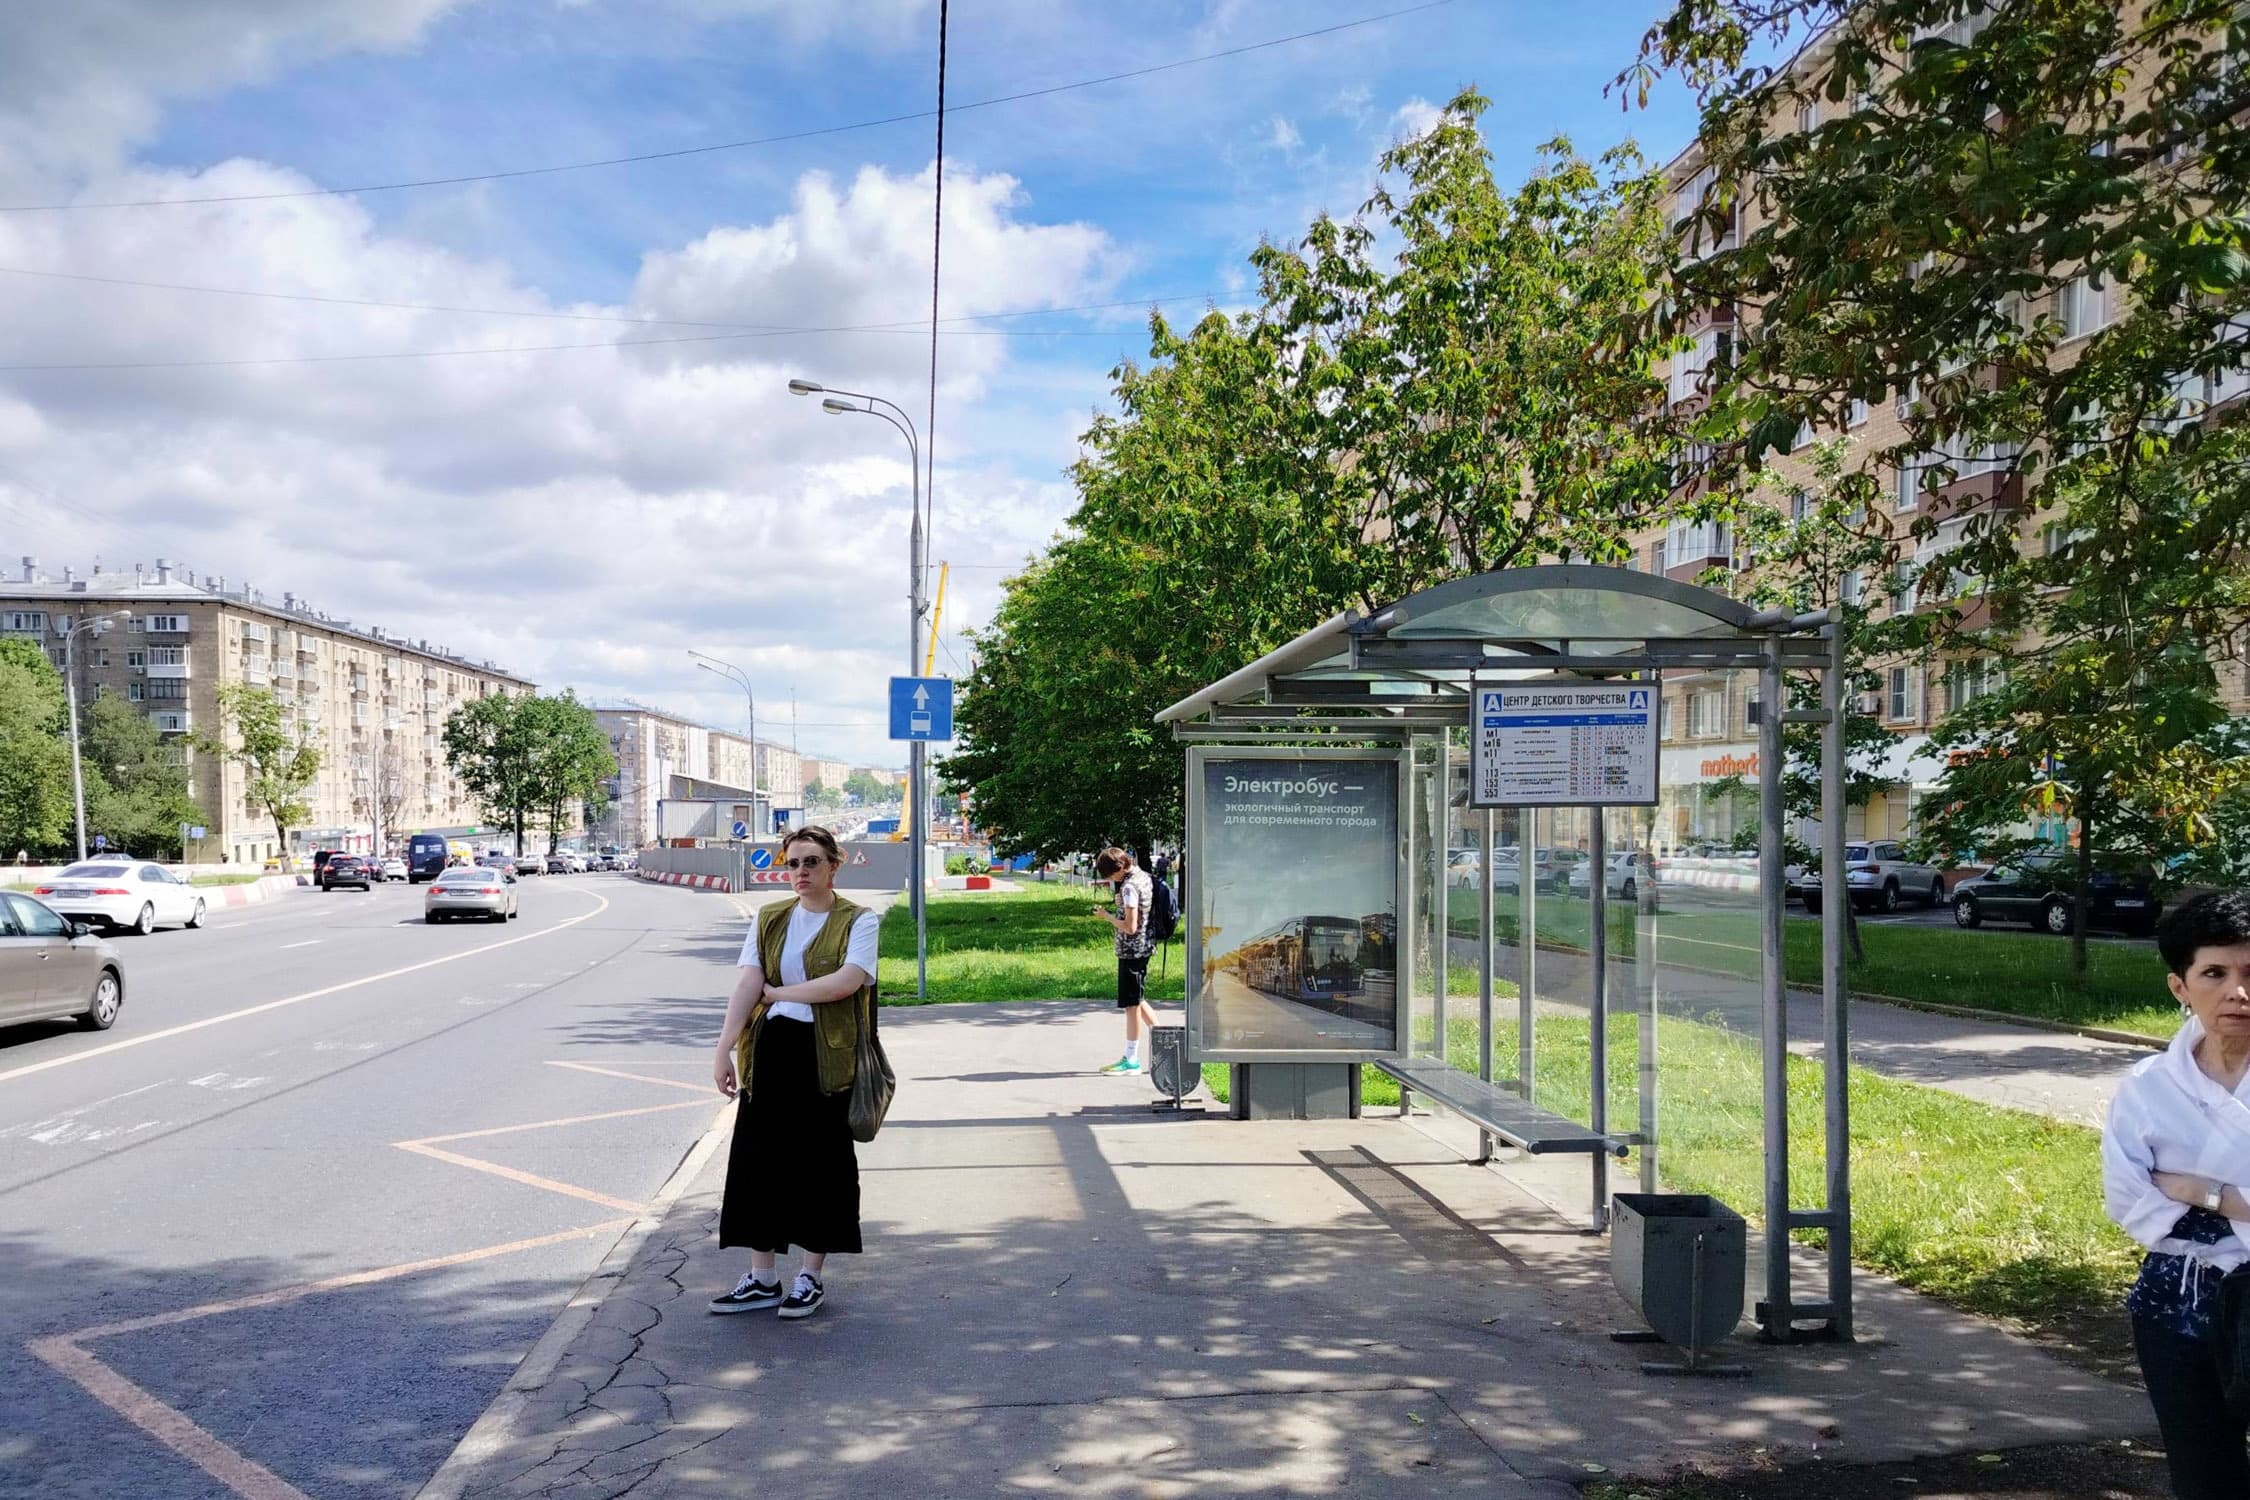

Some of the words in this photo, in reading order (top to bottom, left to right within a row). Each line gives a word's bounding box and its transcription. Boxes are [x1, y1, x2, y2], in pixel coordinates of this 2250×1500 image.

[1503, 696, 1530, 707] ЦЕНТР
[1531, 695, 1573, 707] ДЕТСКОГО
[1576, 694, 1626, 706] ТВОРЧЕСТВА
[1701, 752, 1760, 777] motherc
[1485, 768, 1499, 778] 113
[1224, 776, 1339, 797] Электробус
[1485, 779, 1499, 788] 153
[1484, 788, 1499, 798] 553
[1225, 803, 1300, 813] экологичный
[1303, 805, 1364, 815] транспорт
[1224, 815, 1246, 825] для
[1249, 816, 1333, 827] современного
[1336, 817, 1377, 827] города
